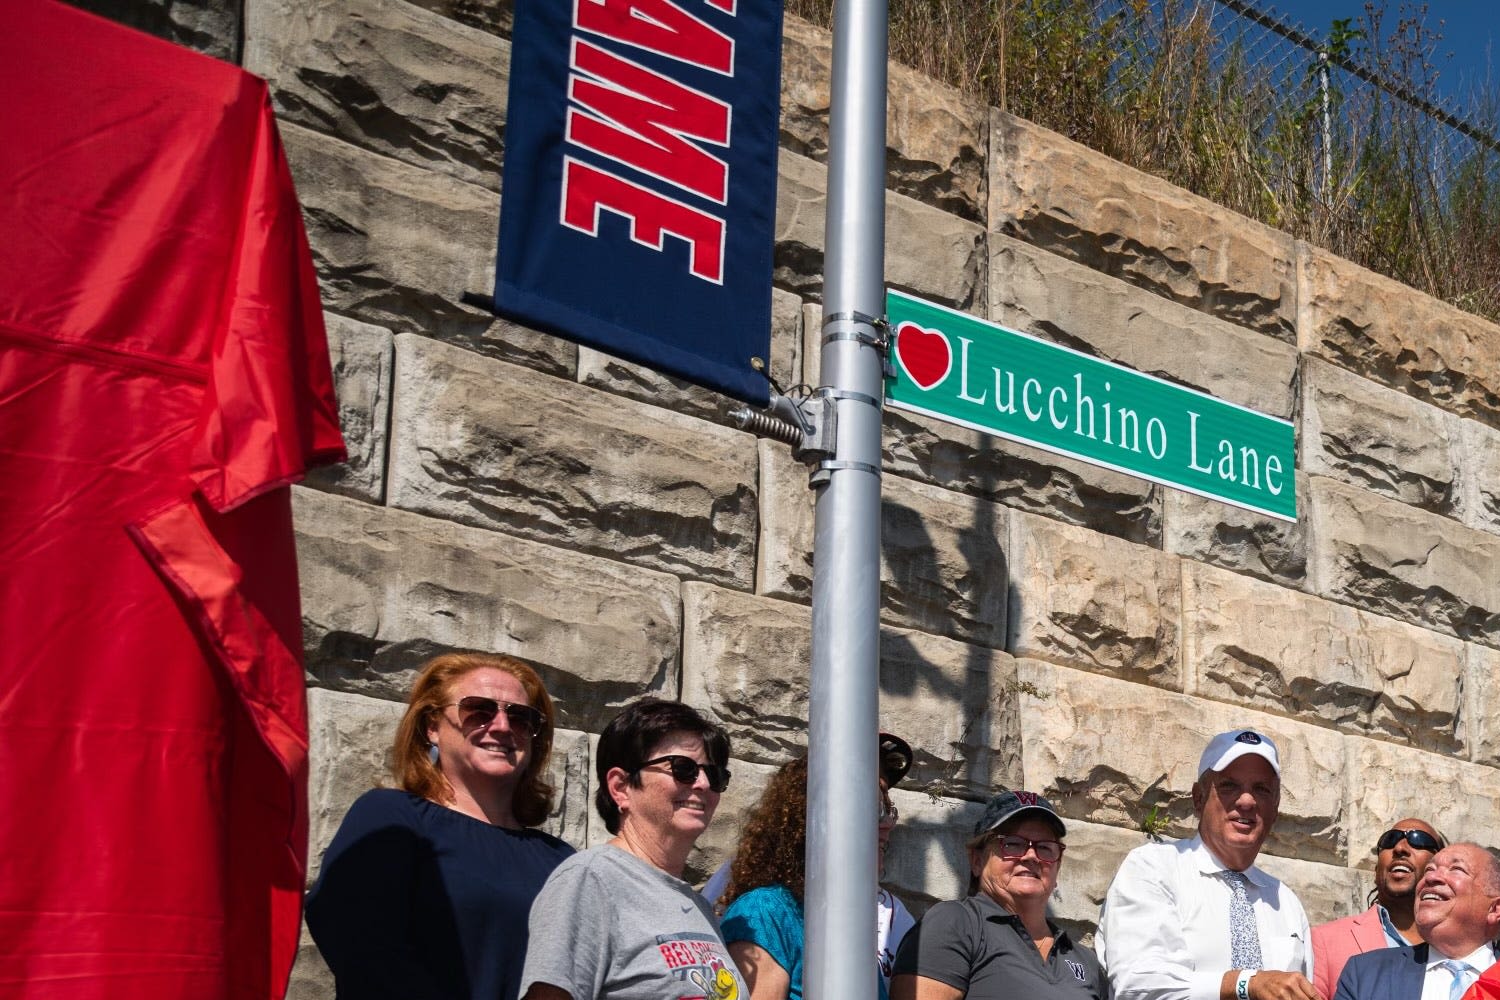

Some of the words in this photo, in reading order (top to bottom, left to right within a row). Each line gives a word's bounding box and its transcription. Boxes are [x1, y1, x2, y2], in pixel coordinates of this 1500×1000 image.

[559, 0, 737, 286] AME
[957, 336, 1167, 460] Lucchino
[1186, 410, 1283, 496] Lane
